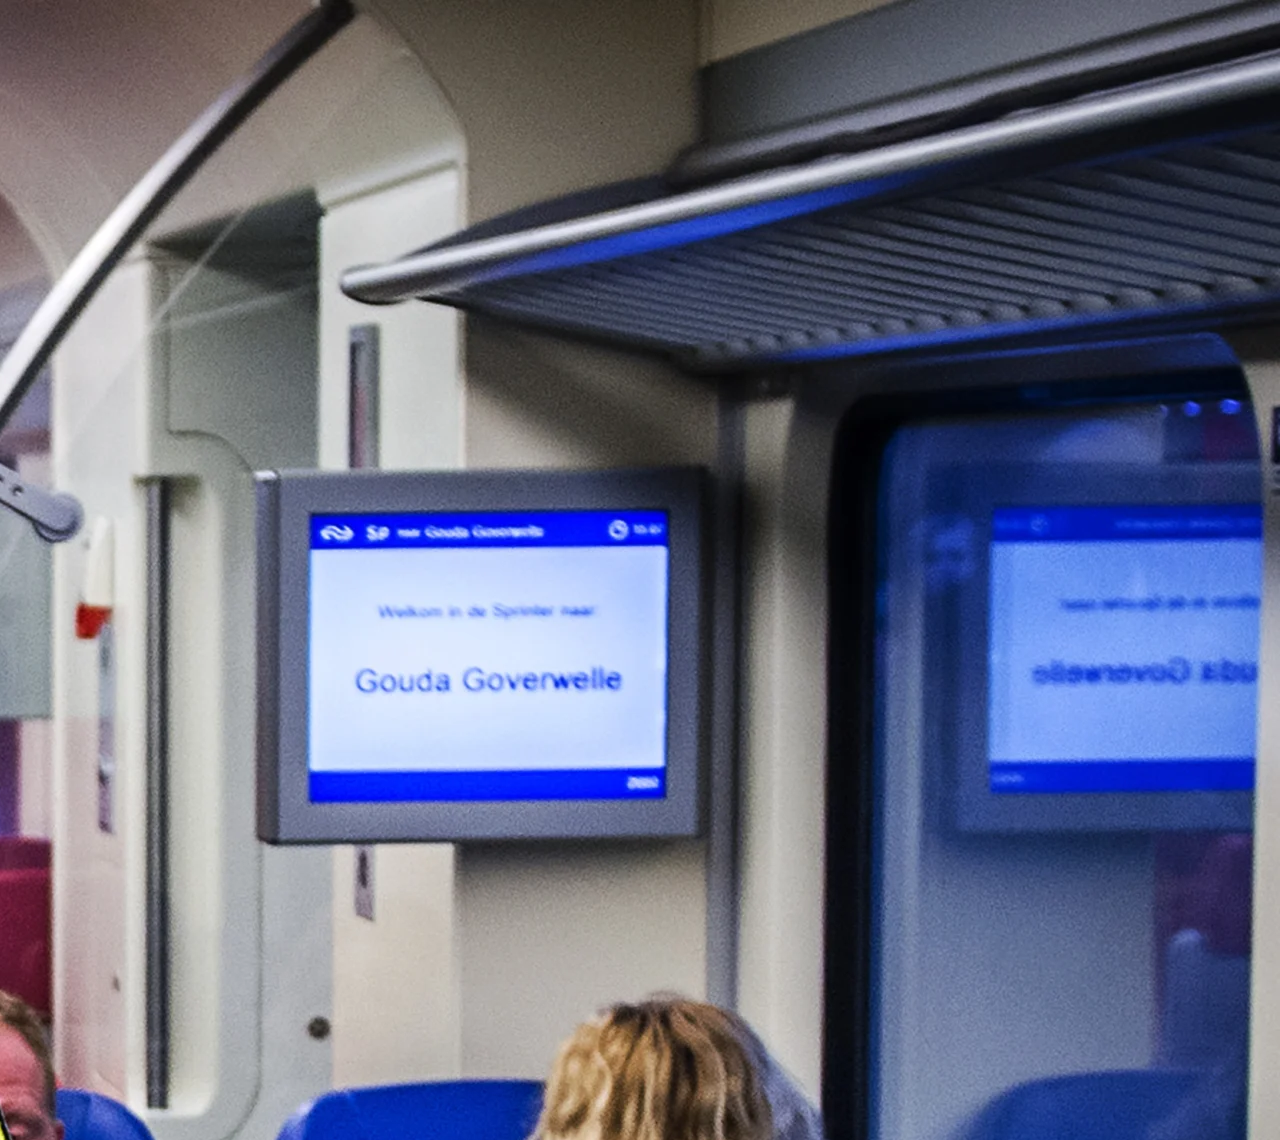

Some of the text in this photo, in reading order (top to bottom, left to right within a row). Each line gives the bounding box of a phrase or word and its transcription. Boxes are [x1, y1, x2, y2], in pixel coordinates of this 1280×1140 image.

[378, 604, 442, 618] Welkom
[467, 603, 487, 618] de
[492, 602, 553, 621] Sprinter
[355, 666, 622, 694] Gouda Goverwelle
